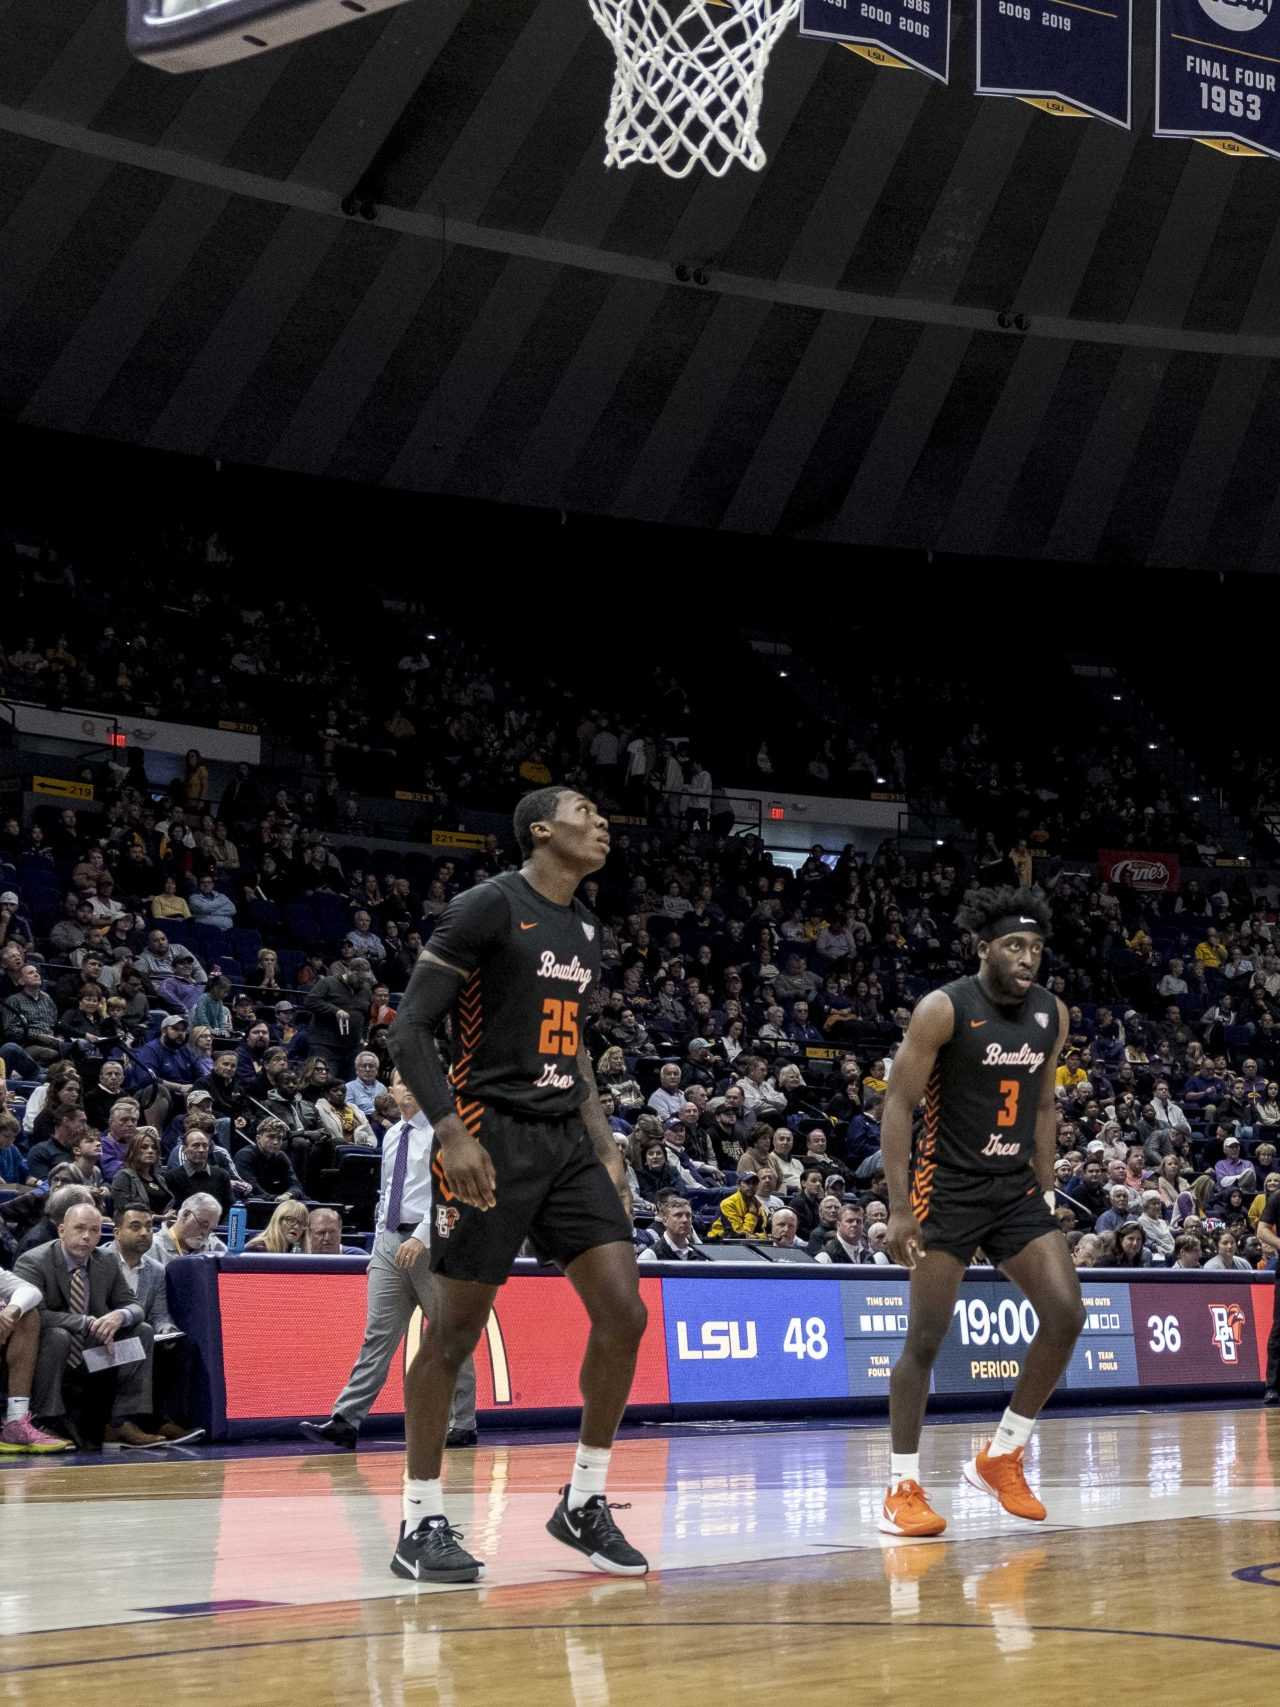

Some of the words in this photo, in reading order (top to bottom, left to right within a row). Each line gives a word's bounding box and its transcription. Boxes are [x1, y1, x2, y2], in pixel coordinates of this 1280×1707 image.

[1186, 55, 1230, 82] FINAL
[1235, 66, 1277, 93] FOUR
[1200, 81, 1262, 121] 1953
[70, 785, 91, 797] 219
[435, 834, 453, 843] 221
[537, 951, 592, 994] Bowling
[538, 998, 579, 1056] 25
[982, 1042, 1045, 1073] Bowling
[997, 1081, 1020, 1126] 3
[866, 1297, 883, 1306] TIME
[884, 1297, 903, 1306] OUTS
[1095, 1297, 1111, 1306] OUTS
[953, 1298, 1040, 1346] 19:00
[1147, 1315, 1182, 1353] 36
[676, 1320, 757, 1360] LSU
[783, 1316, 829, 1360] 48
[870, 1356, 890, 1365] TEAM
[1084, 1350, 1093, 1370] 1
[1098, 1351, 1114, 1361] TEAM
[1099, 1362, 1118, 1371] FOULS
[868, 1368, 891, 1377] FOULS
[970, 1360, 1019, 1379] PERIOD
